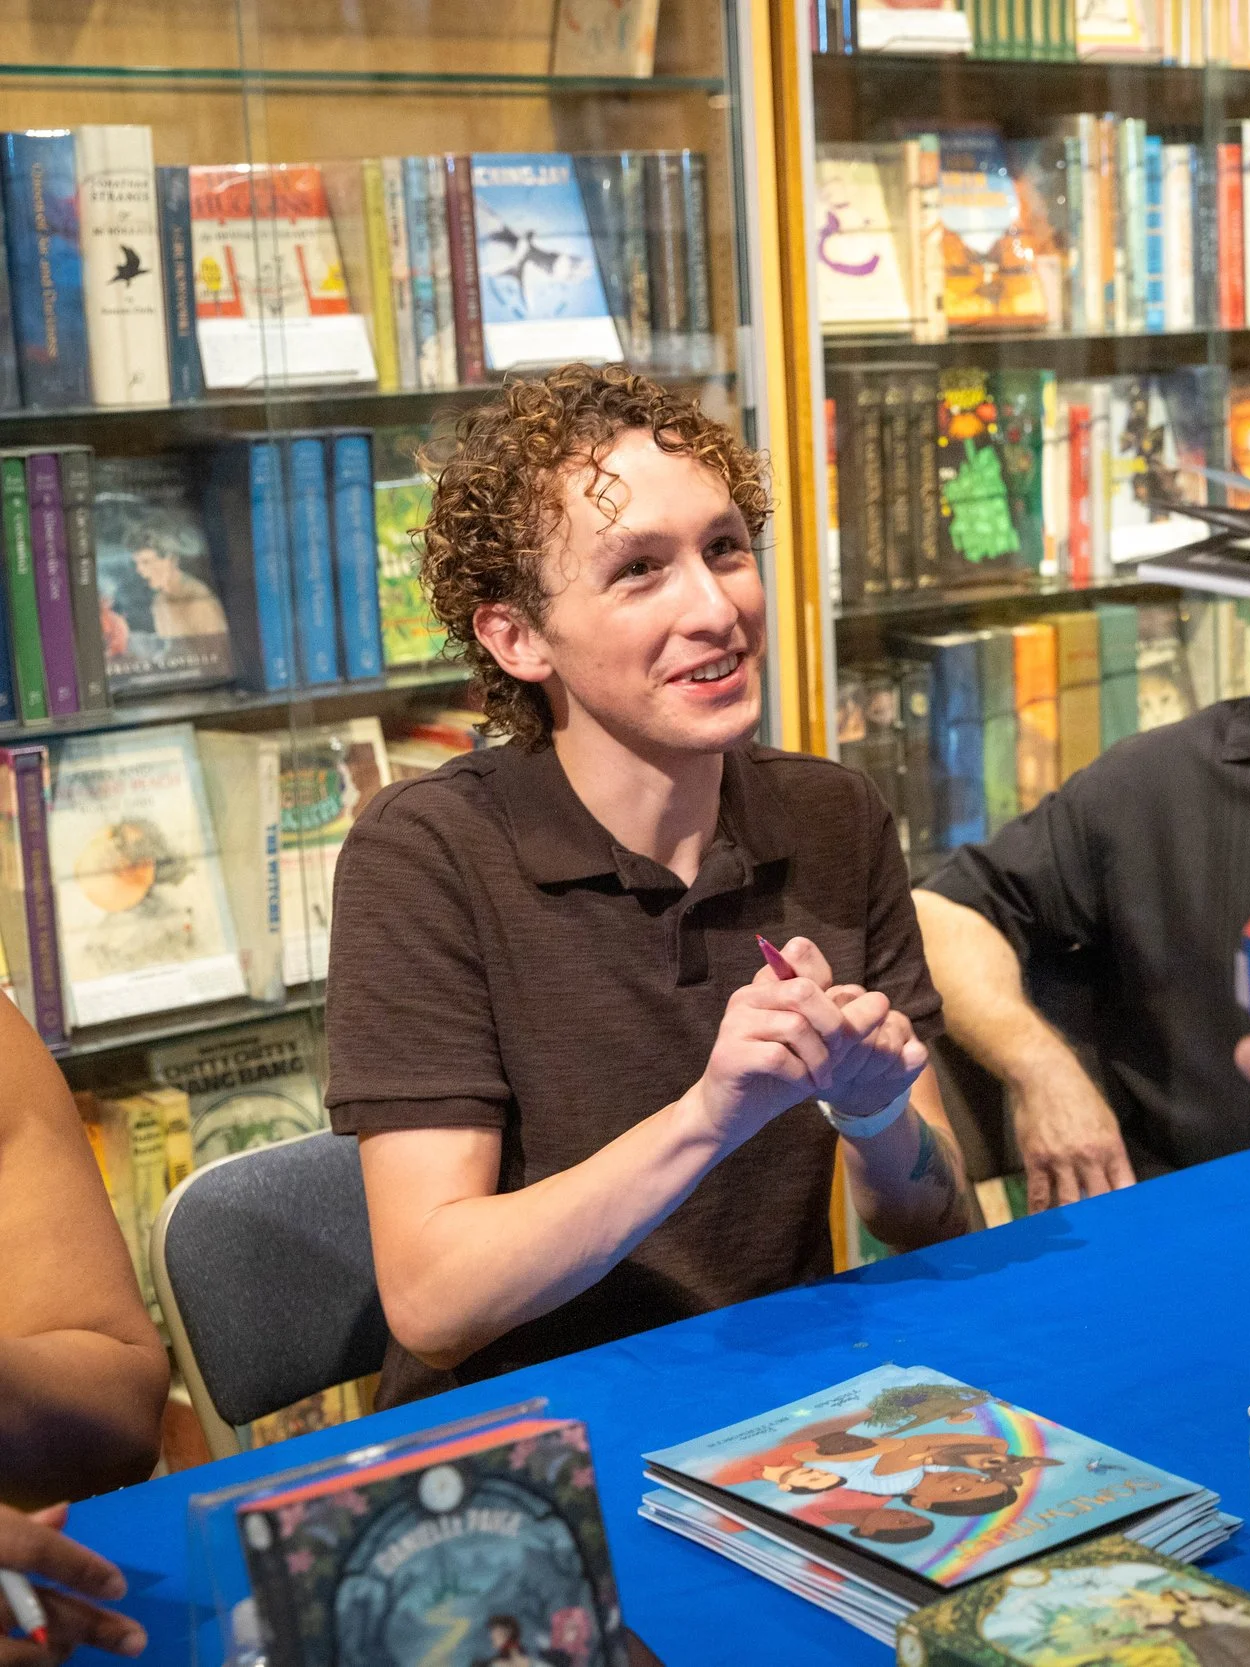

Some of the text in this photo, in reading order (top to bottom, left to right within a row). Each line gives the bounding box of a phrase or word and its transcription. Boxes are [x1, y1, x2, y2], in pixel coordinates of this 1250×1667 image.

[265, 824, 281, 934] THE WITCHES
[239, 1057, 304, 1085] BANG
